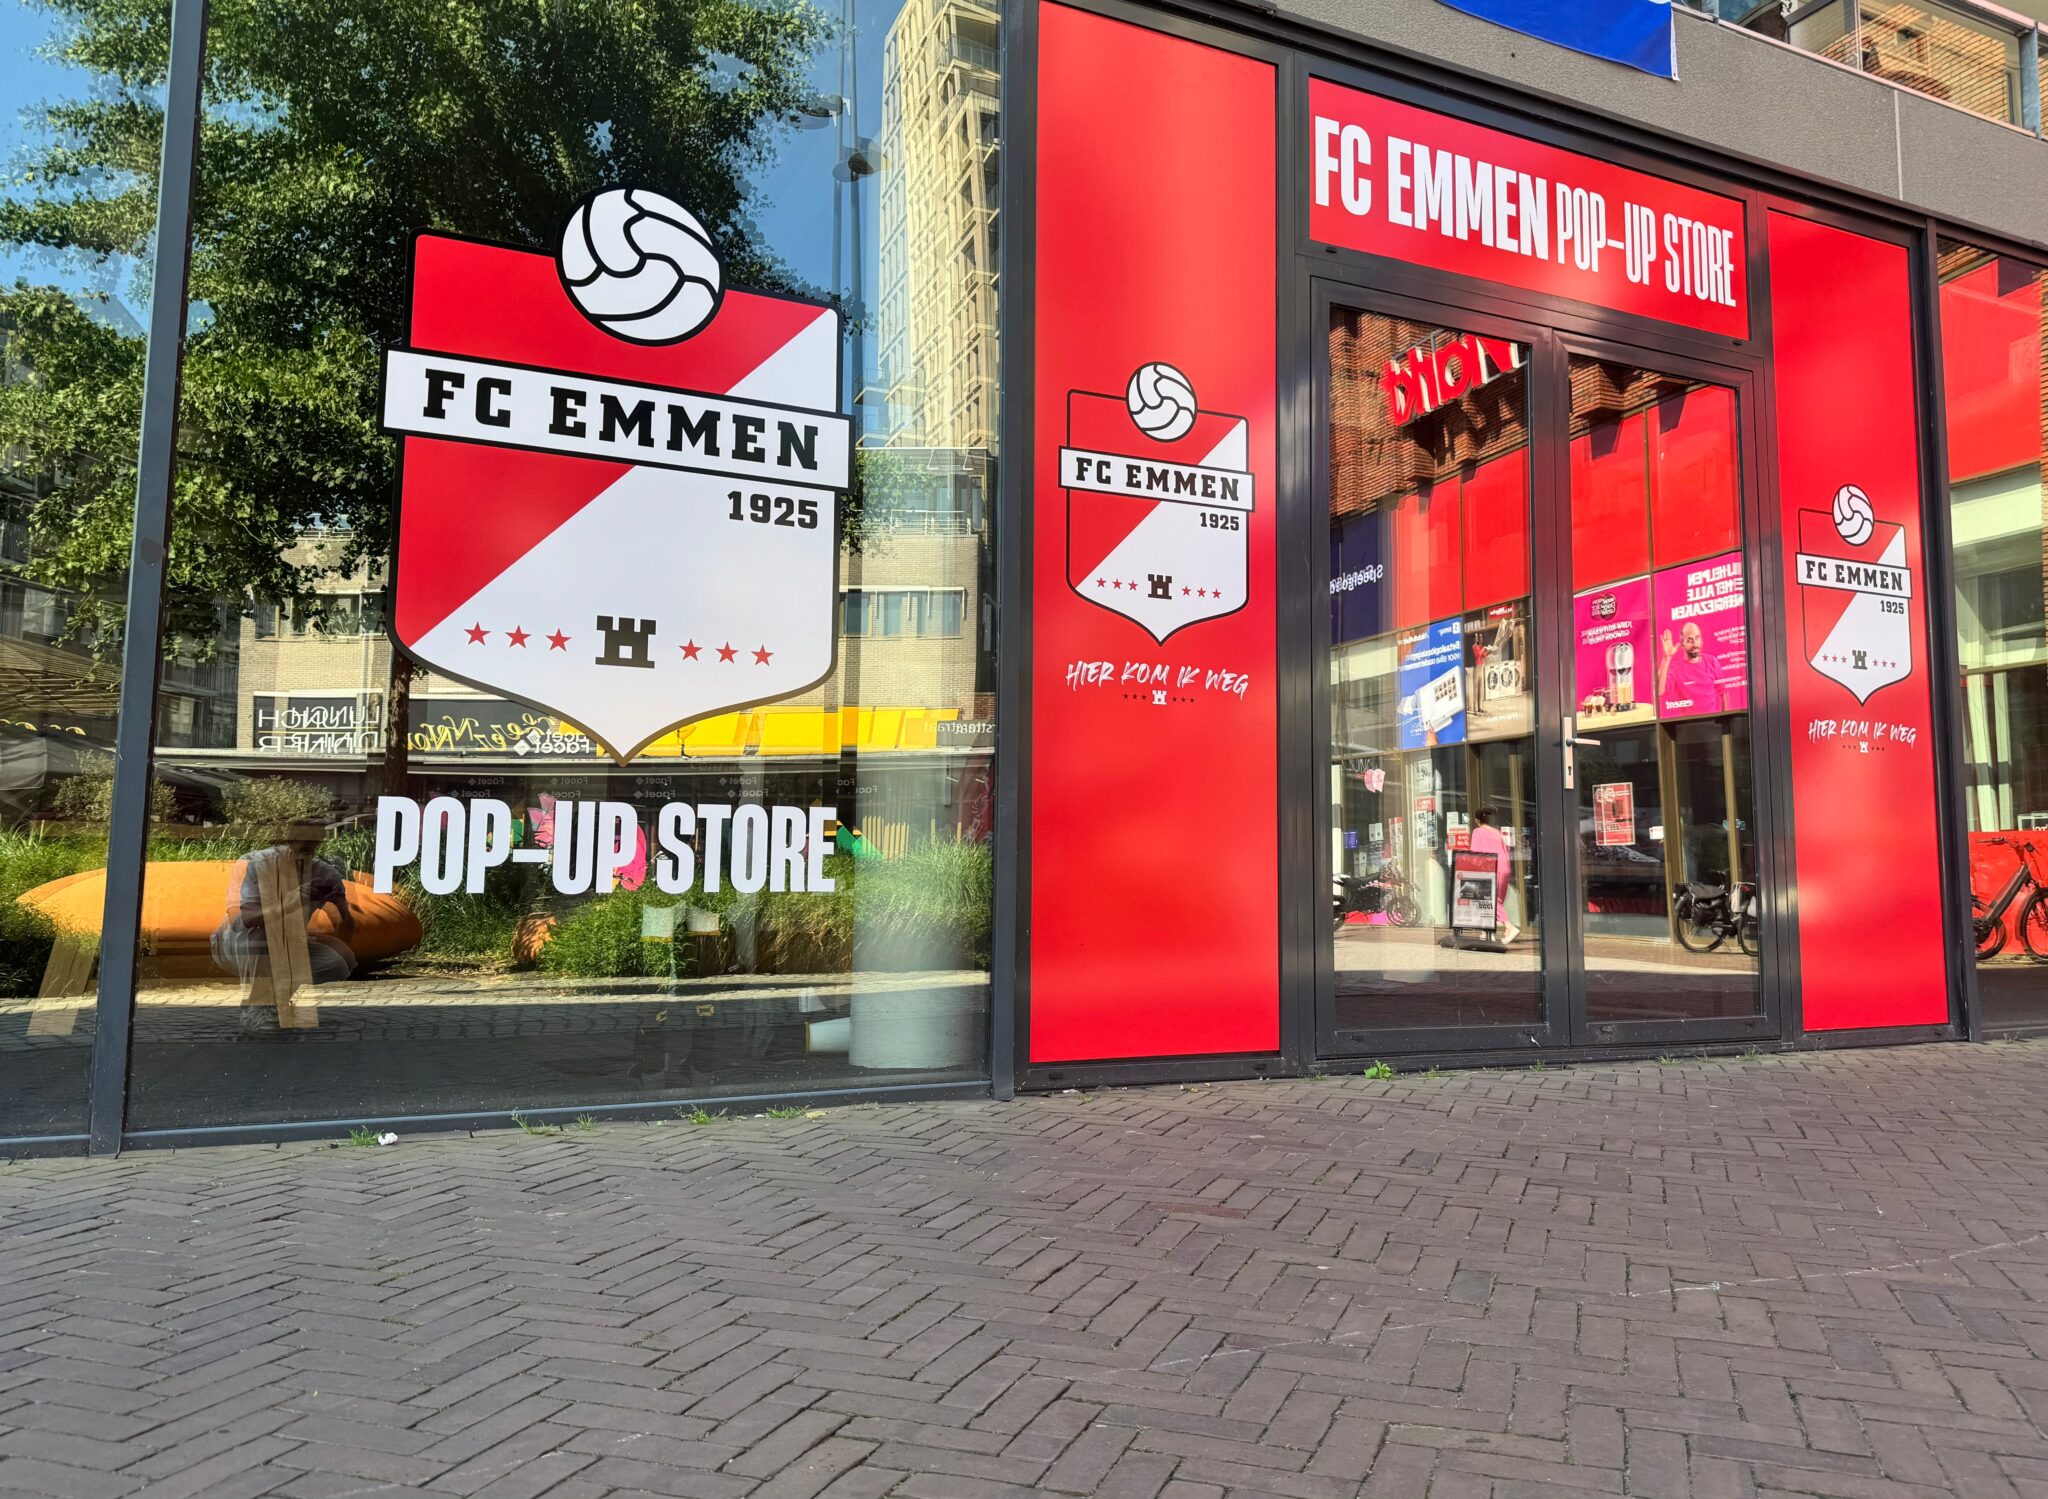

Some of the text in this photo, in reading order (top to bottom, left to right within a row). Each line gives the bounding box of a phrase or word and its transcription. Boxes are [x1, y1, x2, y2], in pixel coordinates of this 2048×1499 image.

[1314, 116, 1737, 308] FC EMMEN POP-UP STORE
[423, 368, 818, 471] FC EMMEN
[1076, 457, 1240, 502] FC EMMEN
[726, 490, 818, 529] 1925
[1200, 512, 1240, 531] 1925
[1806, 560, 1903, 591] FC EMMEN
[1880, 600, 1905, 615] 1925
[1066, 660, 1249, 701] HIER KOM IK WEG
[1808, 719, 1917, 749] HIER KOM IK WEG
[373, 795, 838, 896] POP-UP STORE
